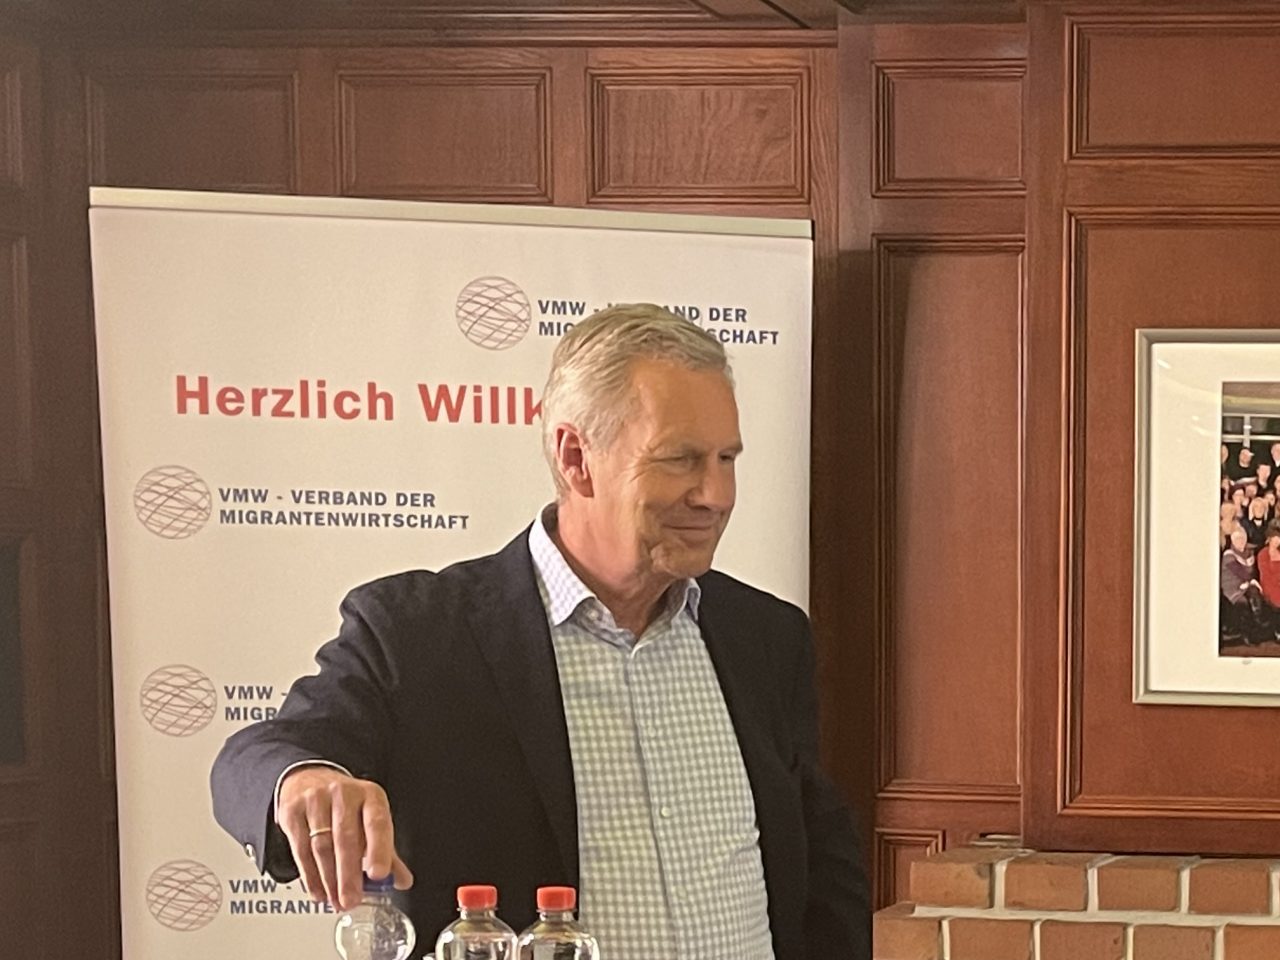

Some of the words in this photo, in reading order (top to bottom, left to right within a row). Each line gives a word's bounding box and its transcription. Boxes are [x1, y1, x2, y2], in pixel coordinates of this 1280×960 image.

[538, 299, 586, 316] VMW
[709, 307, 747, 323] DER
[176, 375, 394, 421] Herzlich
[218, 487, 269, 504] VMW
[291, 489, 388, 506] VERBAND
[396, 492, 436, 508] DER
[219, 509, 470, 530] MIGRANTENWIRTSCHAFT
[224, 685, 273, 700] VMW
[229, 879, 277, 894] VMW
[230, 900, 339, 914] MIGRANTE
